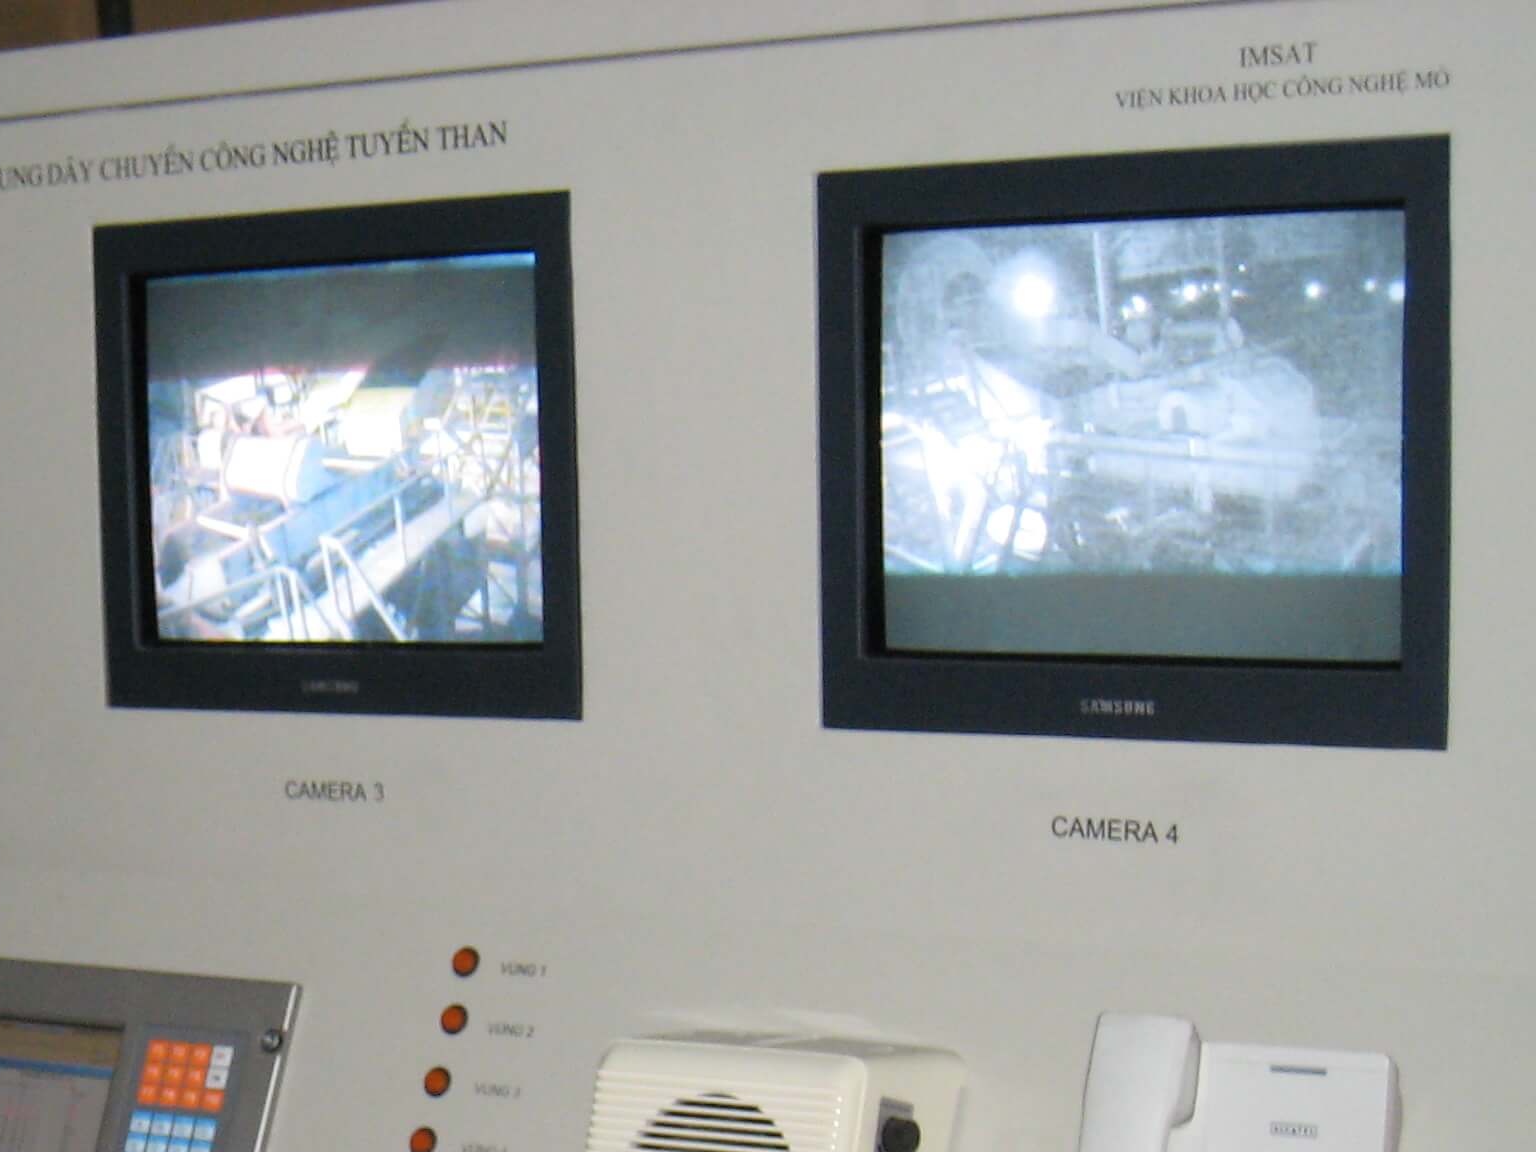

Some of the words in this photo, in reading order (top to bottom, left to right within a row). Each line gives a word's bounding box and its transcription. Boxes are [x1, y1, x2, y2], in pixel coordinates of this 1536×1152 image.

[1239, 42, 1318, 68] IMSAT
[1168, 84, 1227, 105] KHOA
[1282, 74, 1343, 98] CÔNG
[200, 138, 265, 172] CÔNG
[437, 119, 508, 151] THAN
[1079, 698, 1155, 716] SAMSUNG
[284, 779, 367, 802] CAMERA
[373, 780, 385, 803] 3
[1051, 815, 1159, 844] CAMERA
[1165, 823, 1179, 845] 4
